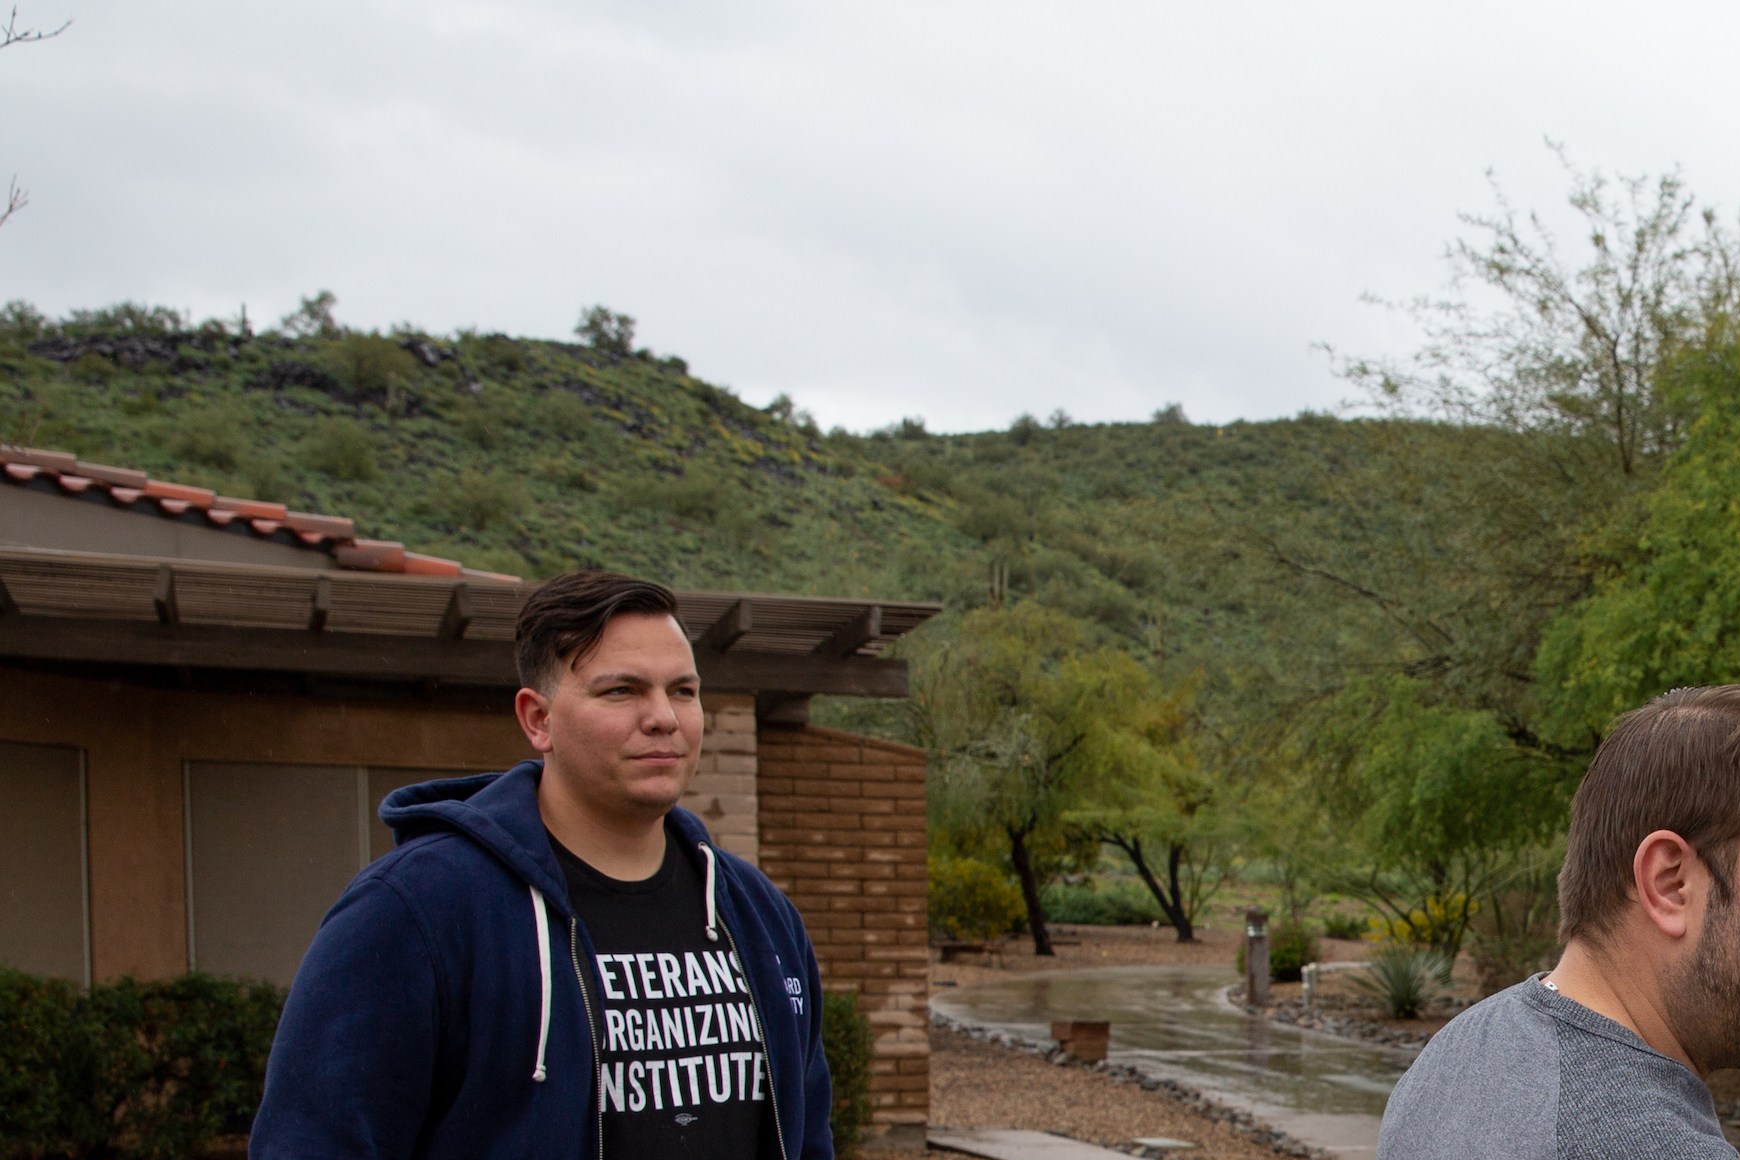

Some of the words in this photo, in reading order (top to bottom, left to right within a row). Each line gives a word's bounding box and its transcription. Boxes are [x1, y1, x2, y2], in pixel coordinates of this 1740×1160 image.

[596, 951, 749, 1000] ETERANS
[602, 1002, 762, 1051] RGANIZIN
[601, 1052, 765, 1112] NSTITUTE
